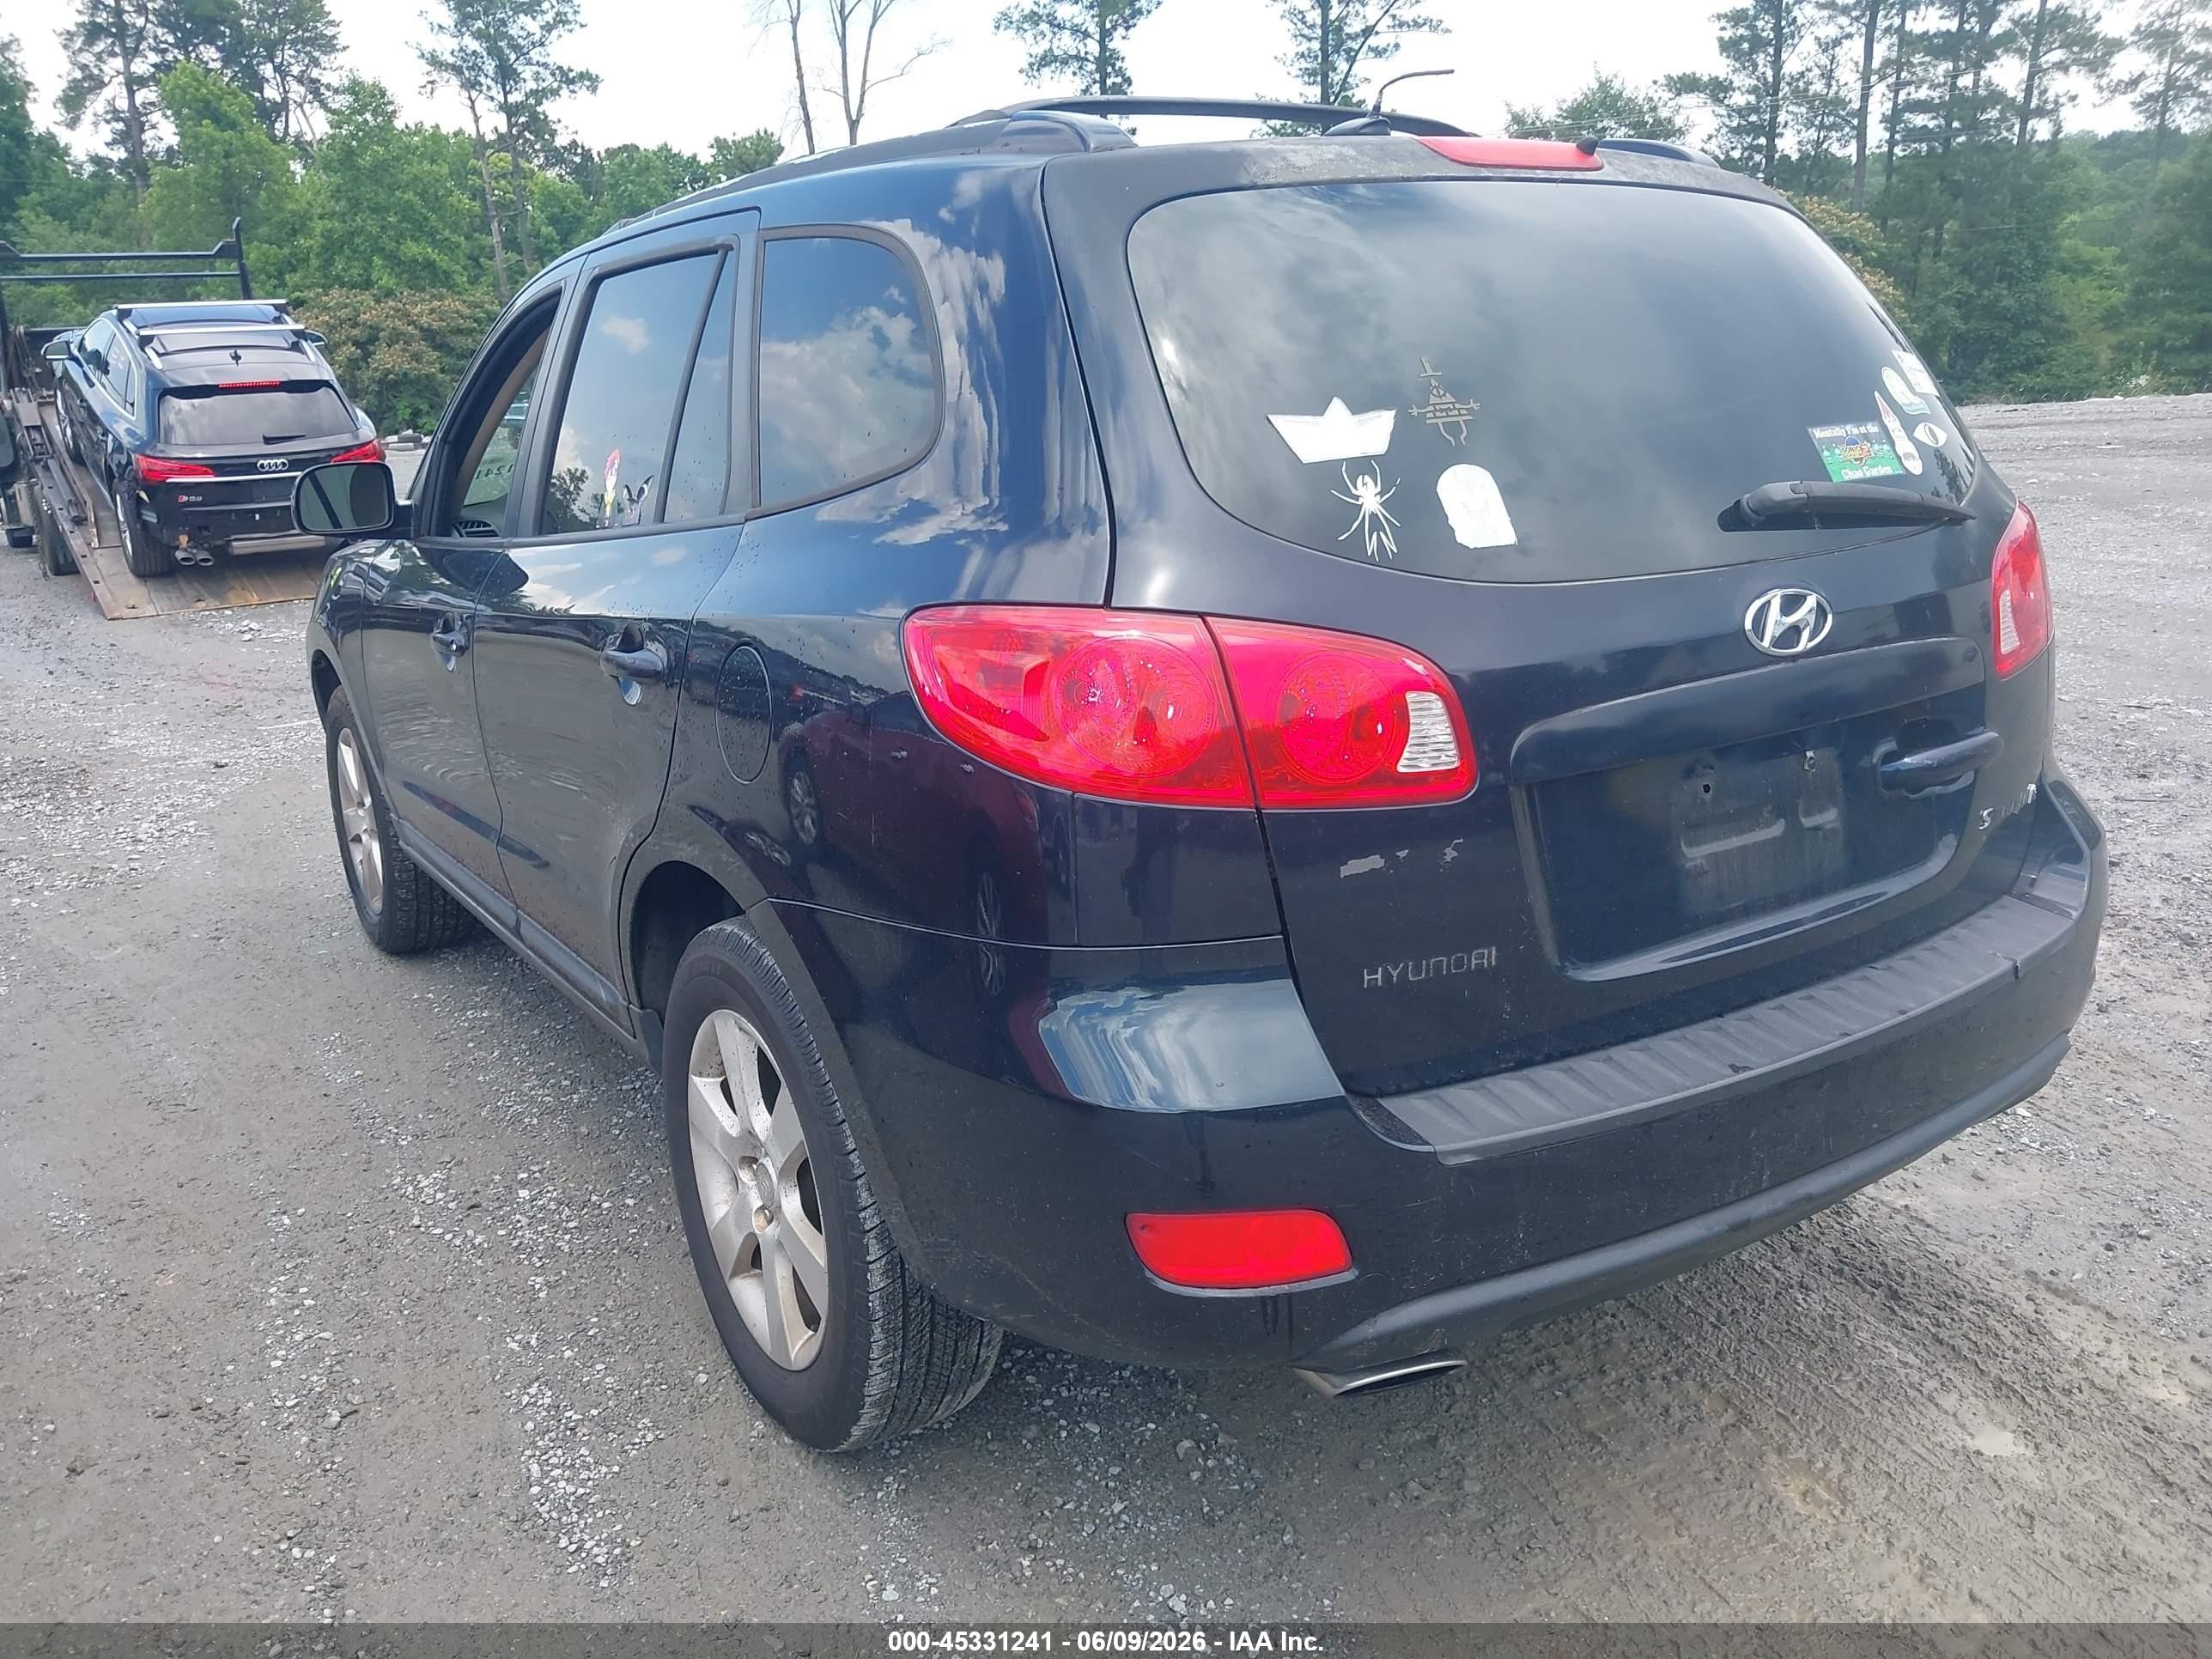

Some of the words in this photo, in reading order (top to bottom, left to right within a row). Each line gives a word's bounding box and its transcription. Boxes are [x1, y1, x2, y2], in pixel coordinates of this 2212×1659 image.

[1813, 426, 1846, 439] Mentally
[1840, 468, 1863, 480] Chao
[1863, 465, 1893, 477] Garden
[1363, 945, 1497, 988] HYUNDAI
